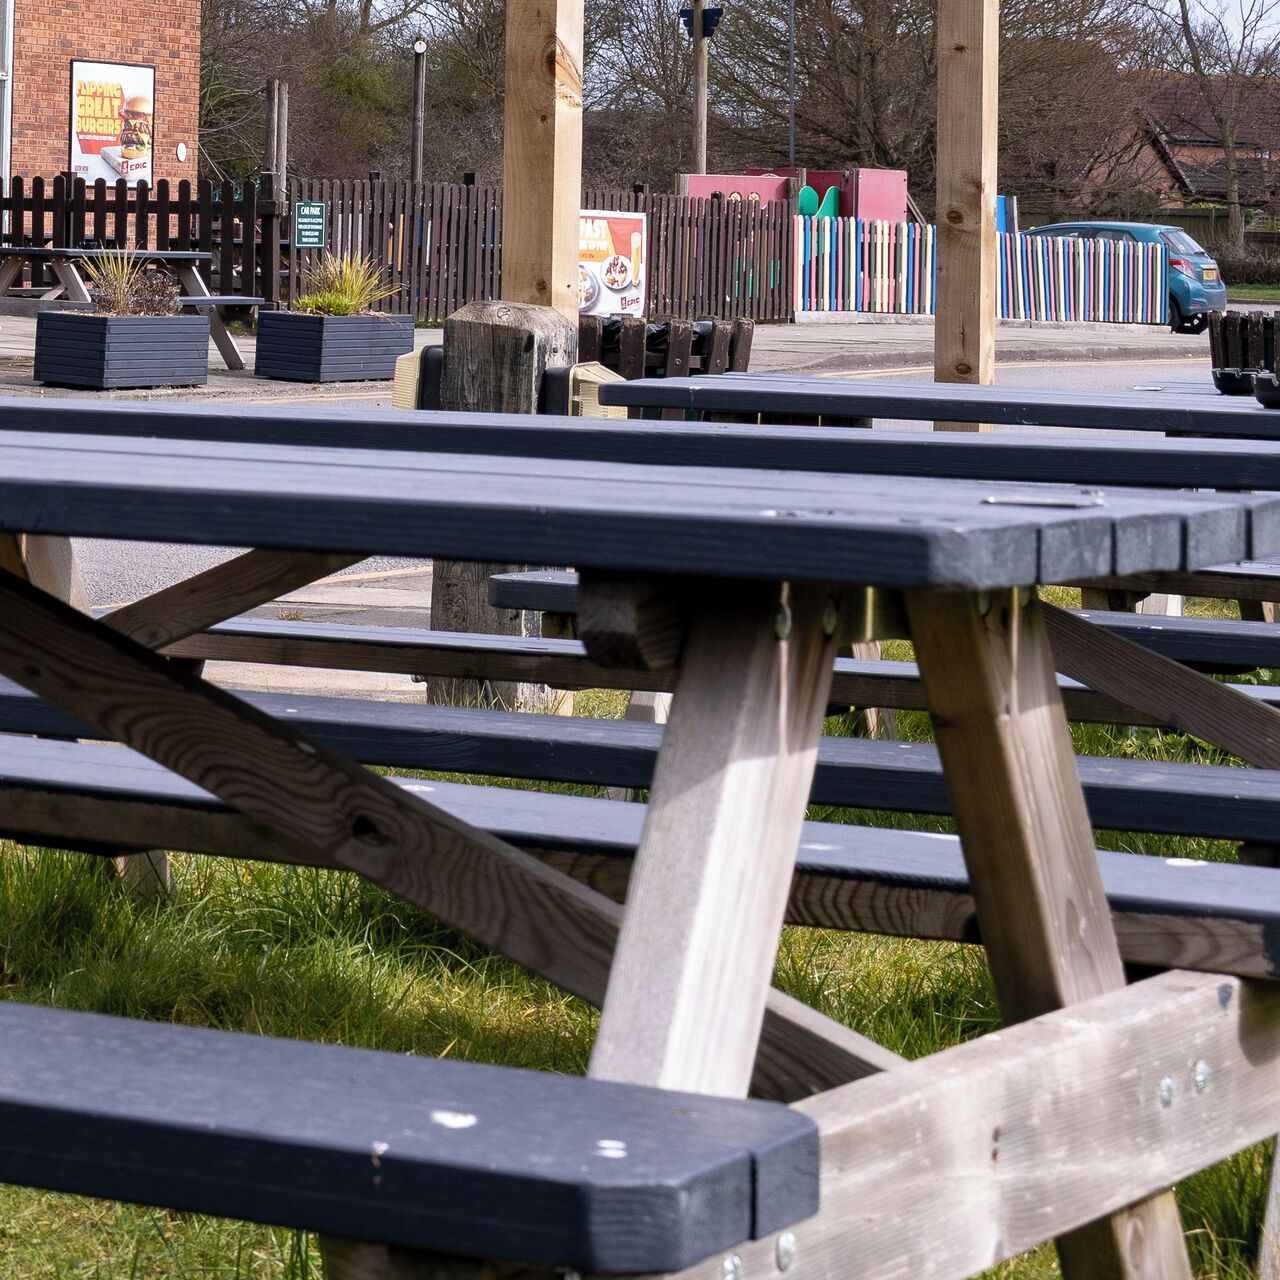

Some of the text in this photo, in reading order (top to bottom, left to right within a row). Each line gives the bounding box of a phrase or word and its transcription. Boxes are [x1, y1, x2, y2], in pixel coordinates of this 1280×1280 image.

[76, 79, 121, 97] FLIPPING
[76, 95, 121, 119] GREAT
[76, 117, 121, 134] BURGERS
[300, 206, 321, 216] CAR PARK
